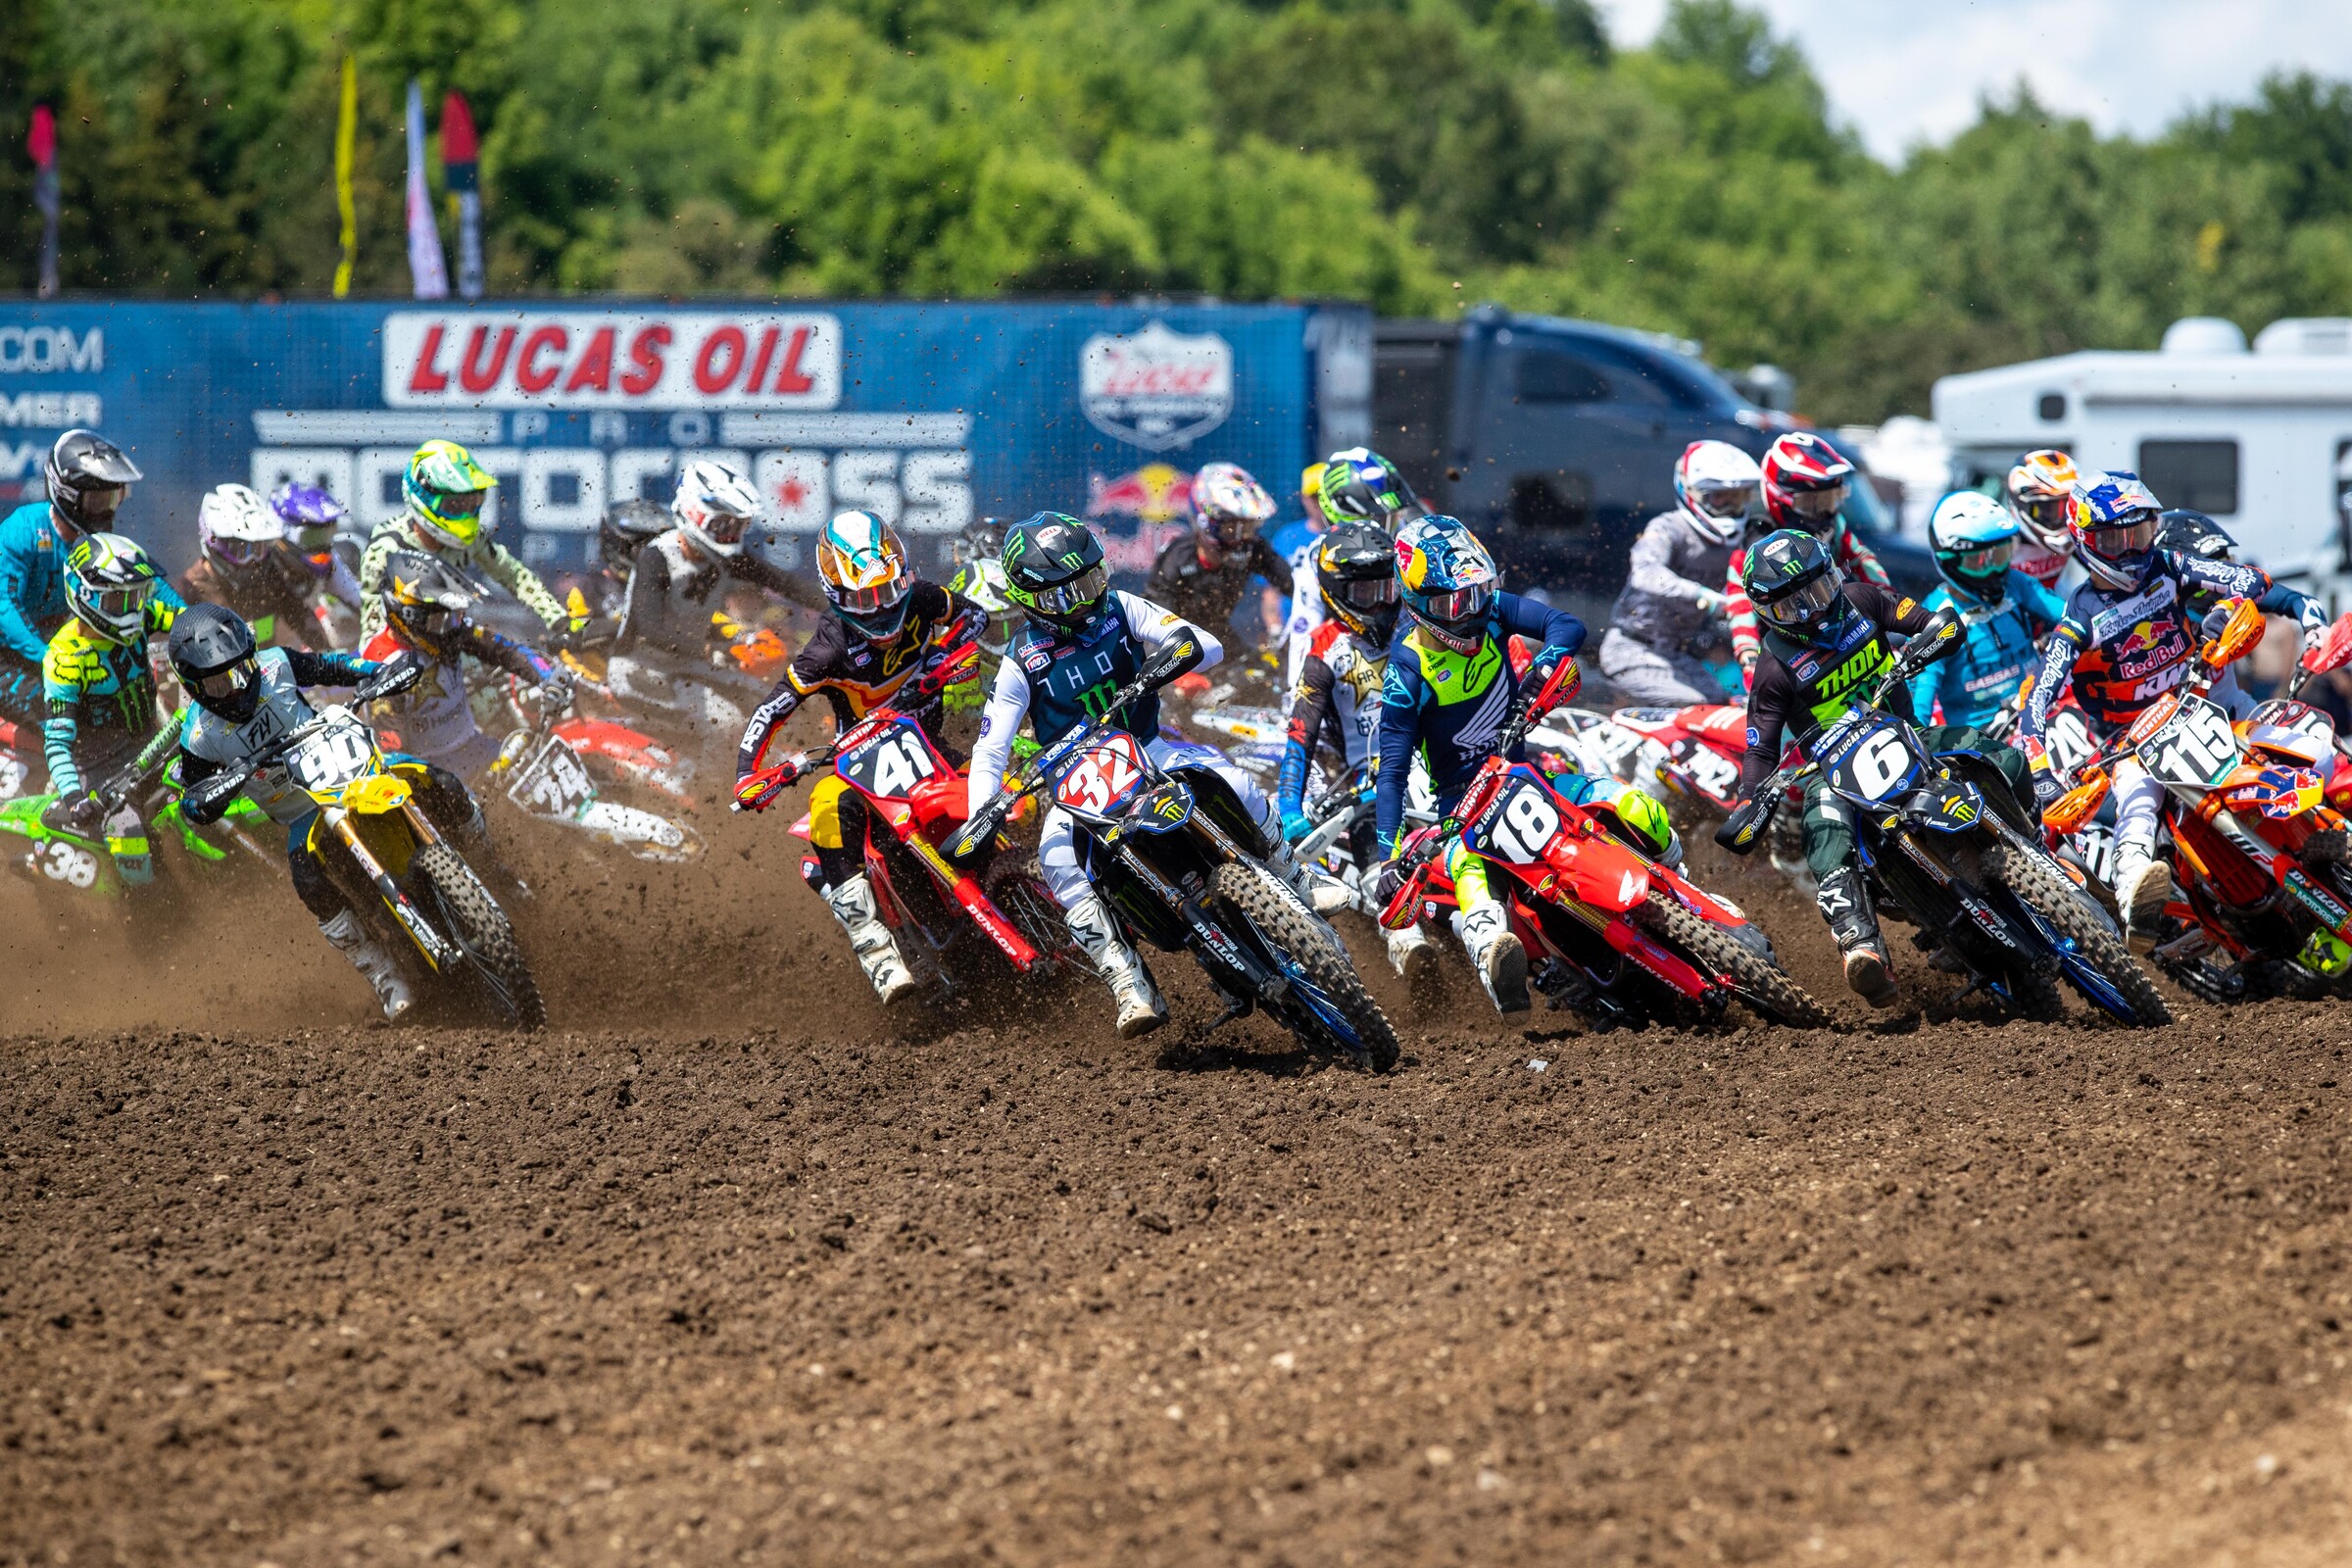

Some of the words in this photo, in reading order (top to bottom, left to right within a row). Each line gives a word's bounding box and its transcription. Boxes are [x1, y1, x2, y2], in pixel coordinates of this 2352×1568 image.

[0, 325, 104, 374] COM
[409, 324, 674, 395] LUCAS
[692, 325, 815, 394] OIL
[249, 447, 974, 533] MOOCOSS
[206, 640, 237, 660] FLY
[1844, 619, 1870, 646] YAMAHA
[948, 665, 978, 685] CYCRA
[1157, 655, 1182, 677] CYCRA
[1816, 638, 1883, 700] THOR
[2120, 653, 2157, 679] Red
[2156, 633, 2185, 668] Bull
[375, 665, 416, 696] ACERBIS
[1964, 663, 2020, 693] GASGAS
[248, 711, 271, 748] FLY
[838, 719, 879, 750] RENTHA
[858, 734, 881, 755] LUCAS
[879, 727, 893, 740] OIL
[1838, 732, 1863, 756] LUCAS
[1860, 722, 1873, 737] OIL
[2135, 702, 2176, 740] RENTHAL
[2151, 723, 2177, 748] LUCA
[299, 723, 371, 792] 90
[873, 730, 936, 798] 41
[1085, 736, 1101, 751] OIL
[1458, 735, 1499, 761] HON
[1851, 727, 1910, 801] 6
[2158, 705, 2236, 785] 115
[204, 772, 247, 803] ACERBIS
[756, 783, 782, 805] CYCRA
[1067, 736, 1144, 815] 32
[1480, 799, 1500, 826] LUCAS
[1496, 787, 1510, 803] OIL
[1491, 783, 1559, 865] 18
[970, 819, 992, 844] CYCRA
[44, 841, 97, 889] 38
[2021, 844, 2082, 893] DUNLOP
[1258, 867, 1313, 917] DUNLOP
[2286, 869, 2348, 917] DNLOP
[2296, 890, 2338, 927] MOTOREX
[965, 903, 1018, 956] DUNLOP
[1960, 897, 2017, 950] DUNLOP
[1193, 921, 1247, 972] DUNLOP
[1624, 952, 1687, 995] DUNLOP
